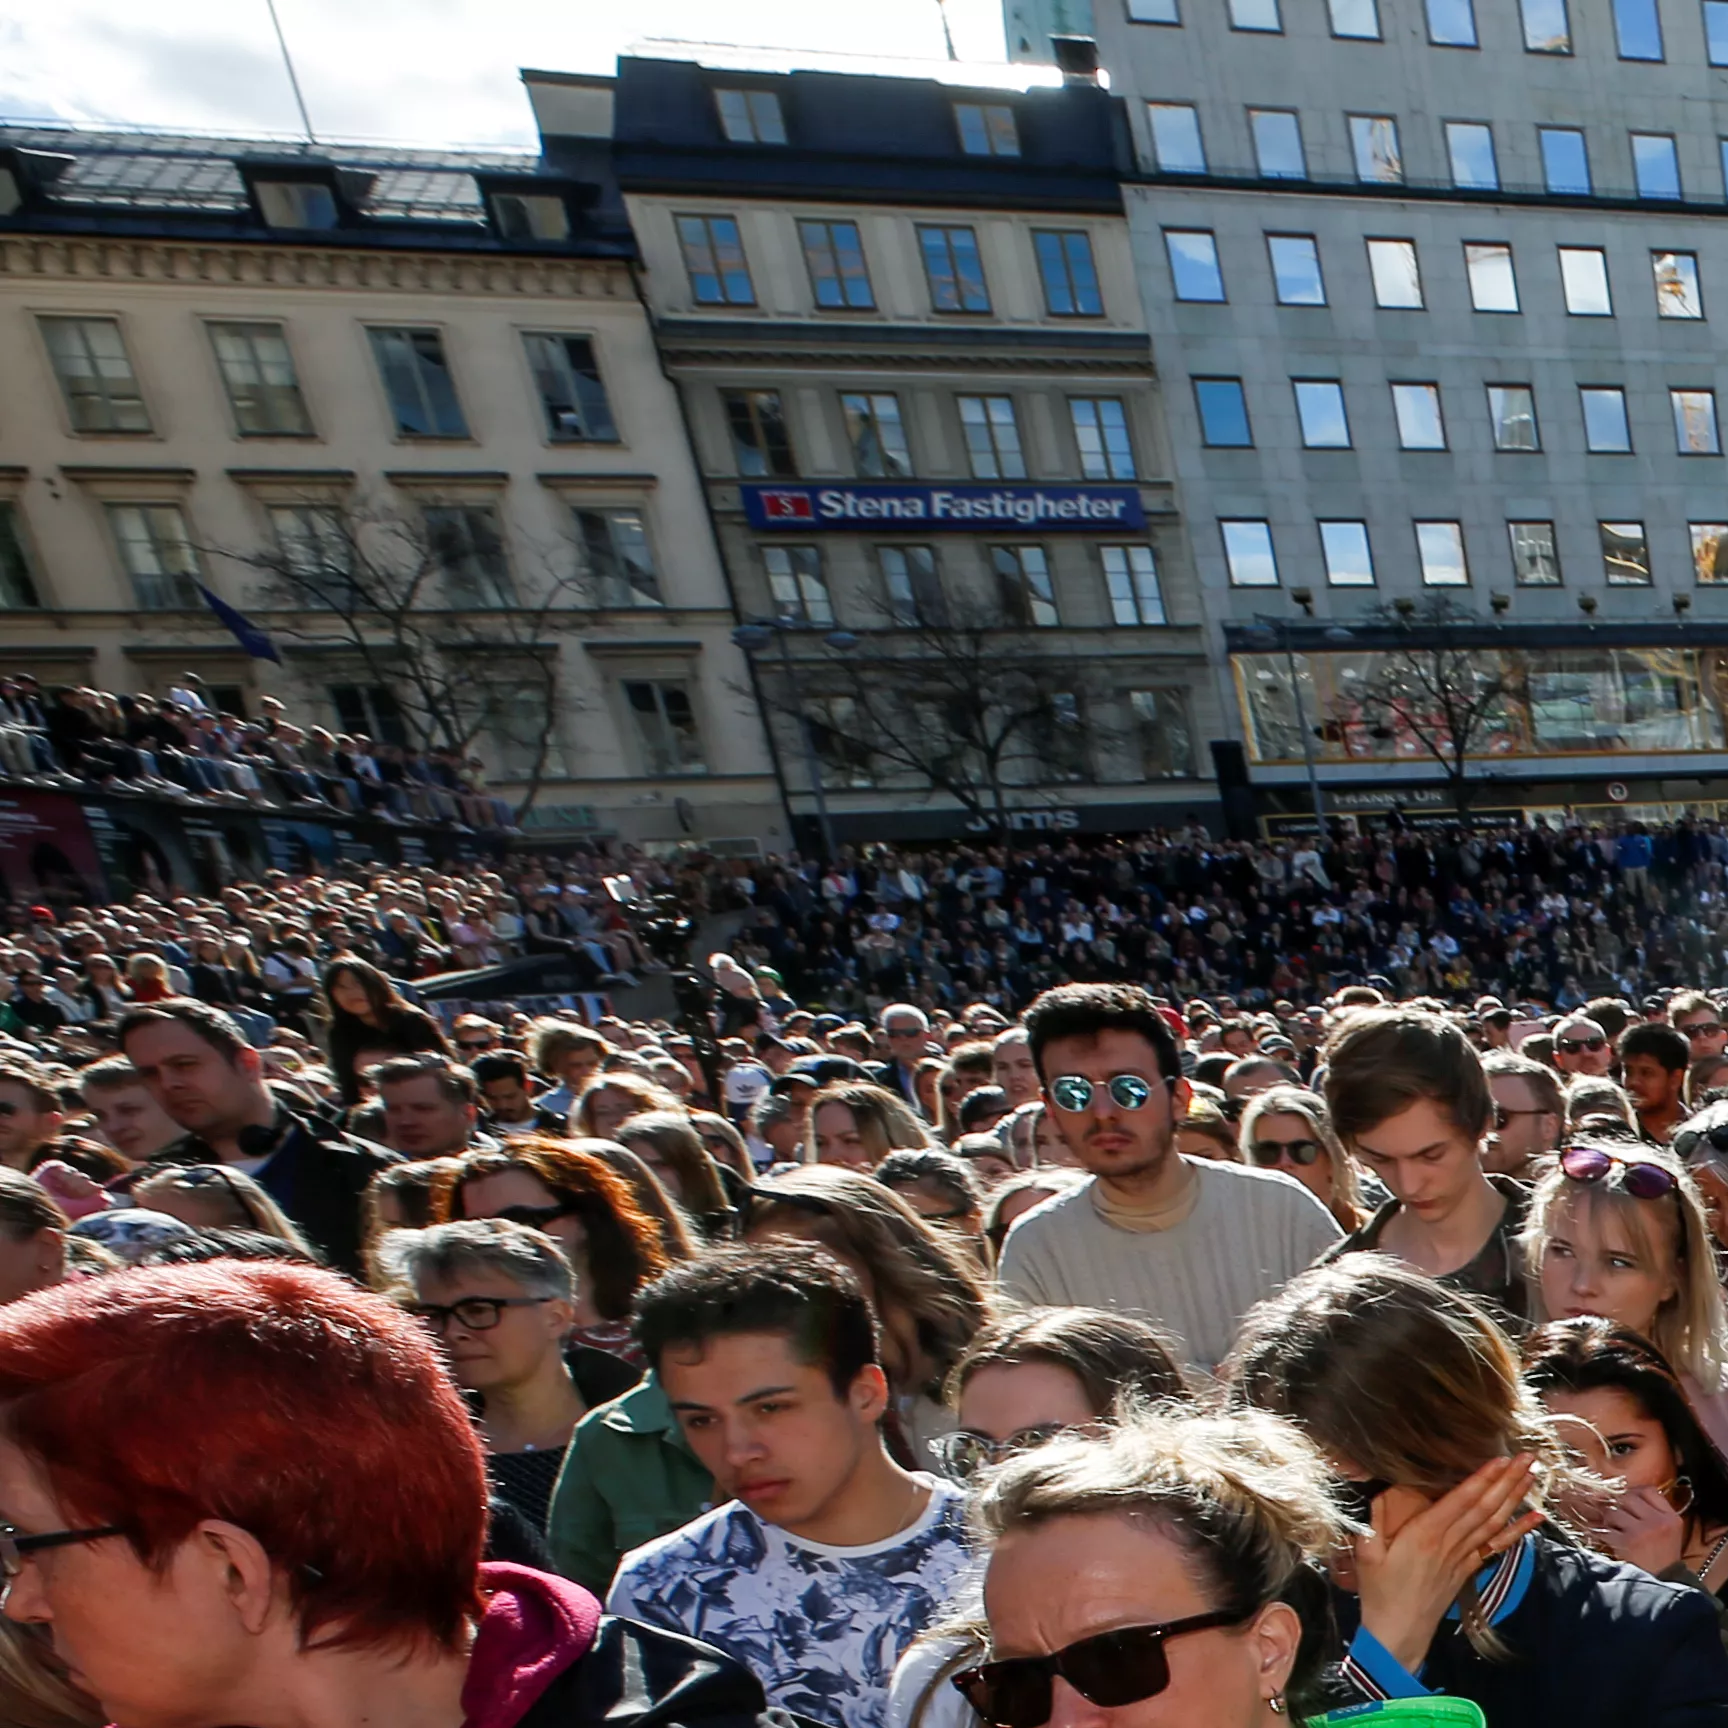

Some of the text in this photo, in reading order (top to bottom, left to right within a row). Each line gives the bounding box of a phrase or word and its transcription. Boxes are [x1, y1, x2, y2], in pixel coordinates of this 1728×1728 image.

[818, 490, 1126, 524] Stena Fastigheter
[965, 808, 1080, 832] Jrns
